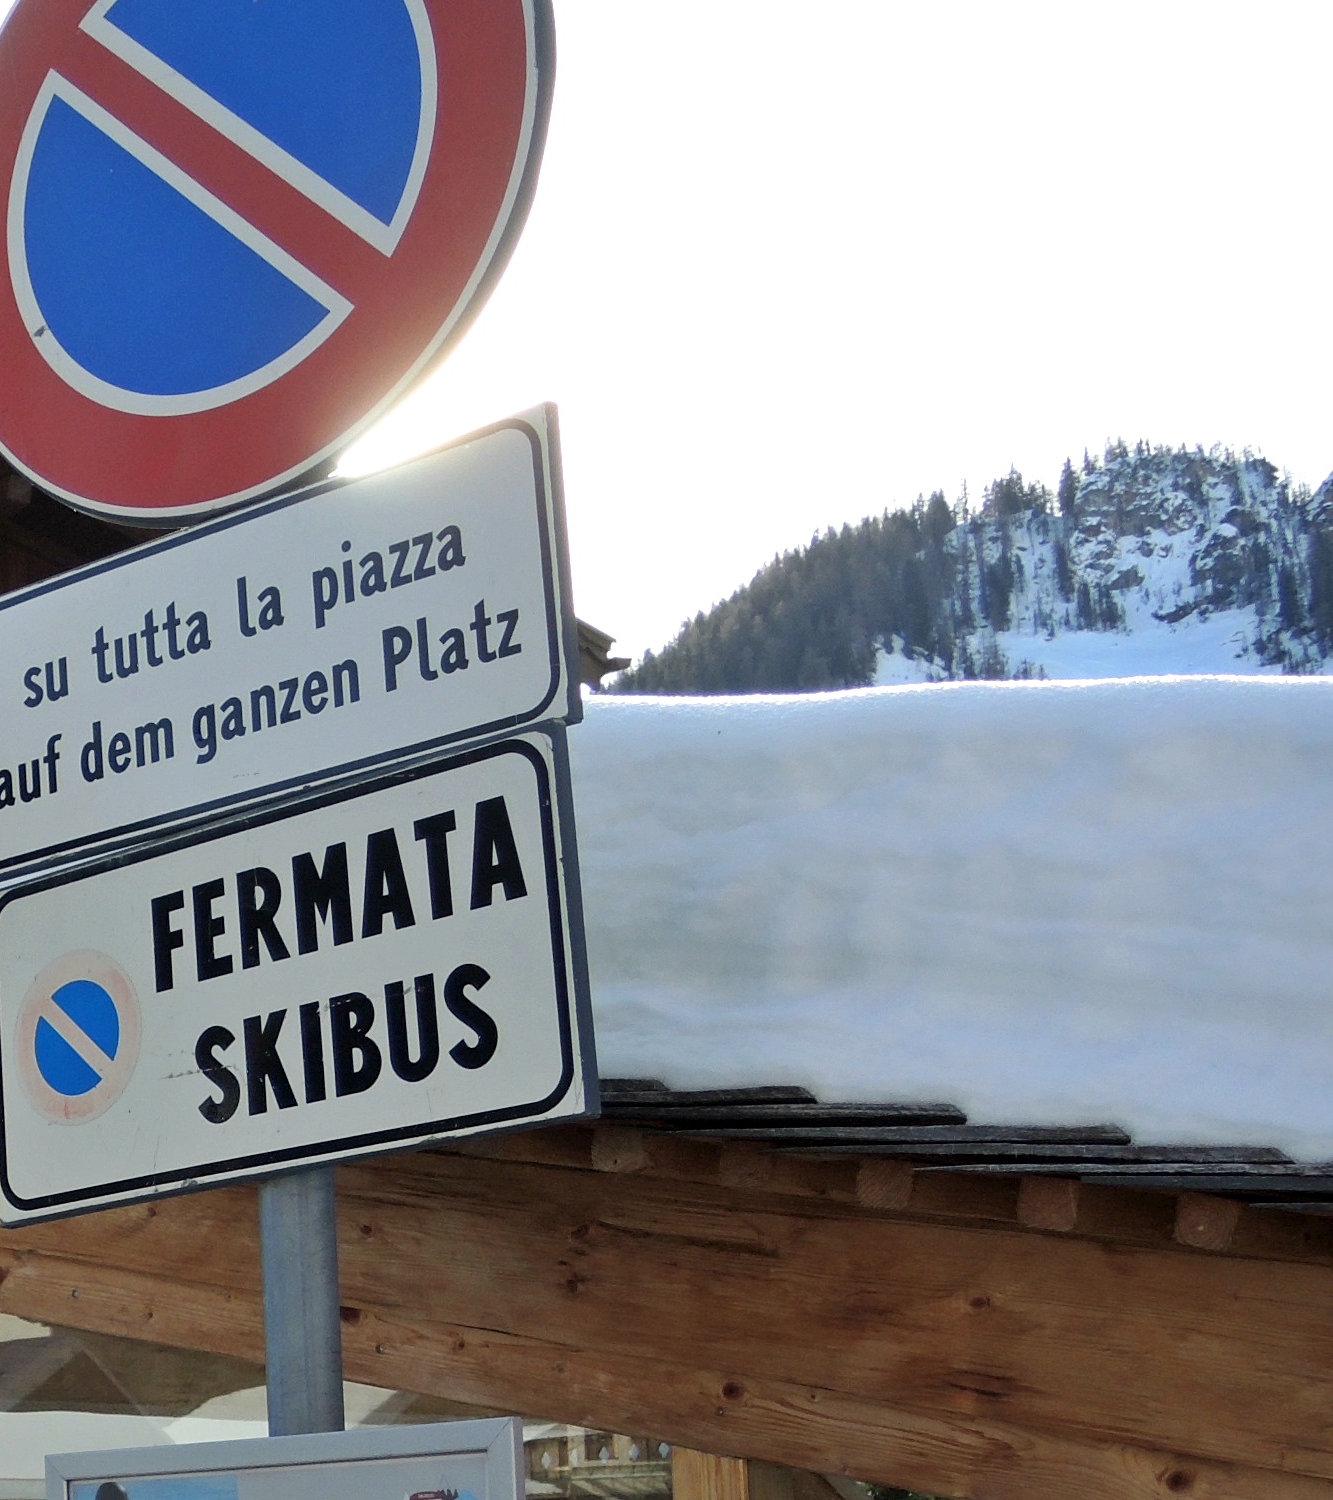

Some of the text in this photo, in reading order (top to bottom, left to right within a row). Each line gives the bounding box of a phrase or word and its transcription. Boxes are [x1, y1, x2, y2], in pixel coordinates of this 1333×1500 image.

[22, 523, 466, 709] su tutta la piazza
[79, 715, 174, 785] dem
[192, 659, 360, 765] ganzen
[383, 598, 523, 693] Platz
[151, 795, 530, 994] FERMATA
[194, 963, 499, 1124] SKIBUS
